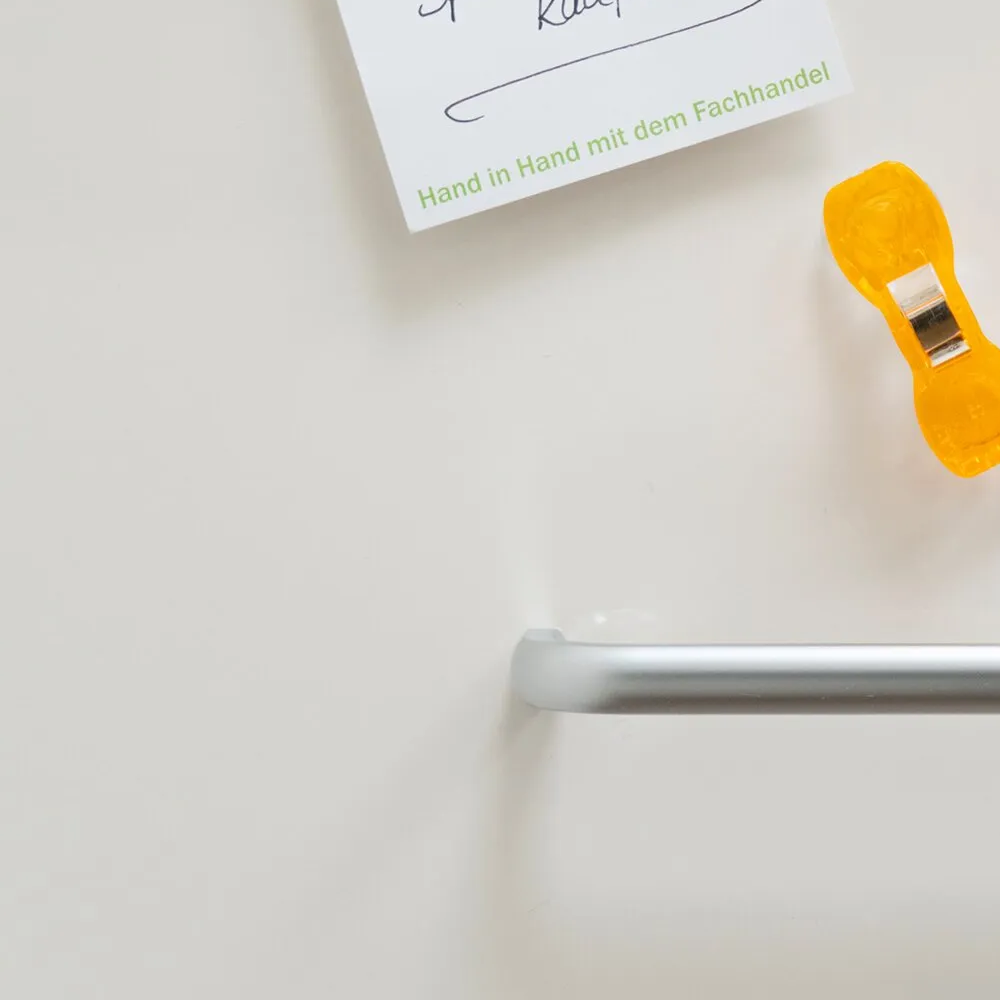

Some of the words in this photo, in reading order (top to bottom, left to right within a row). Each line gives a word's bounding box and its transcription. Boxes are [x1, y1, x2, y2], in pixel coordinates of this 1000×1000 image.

[417, 173, 483, 209] Hand
[488, 165, 512, 186] in
[515, 142, 581, 178] Hand
[586, 127, 629, 154] mit
[633, 111, 688, 140] dem
[692, 60, 832, 122] Fachhandel
